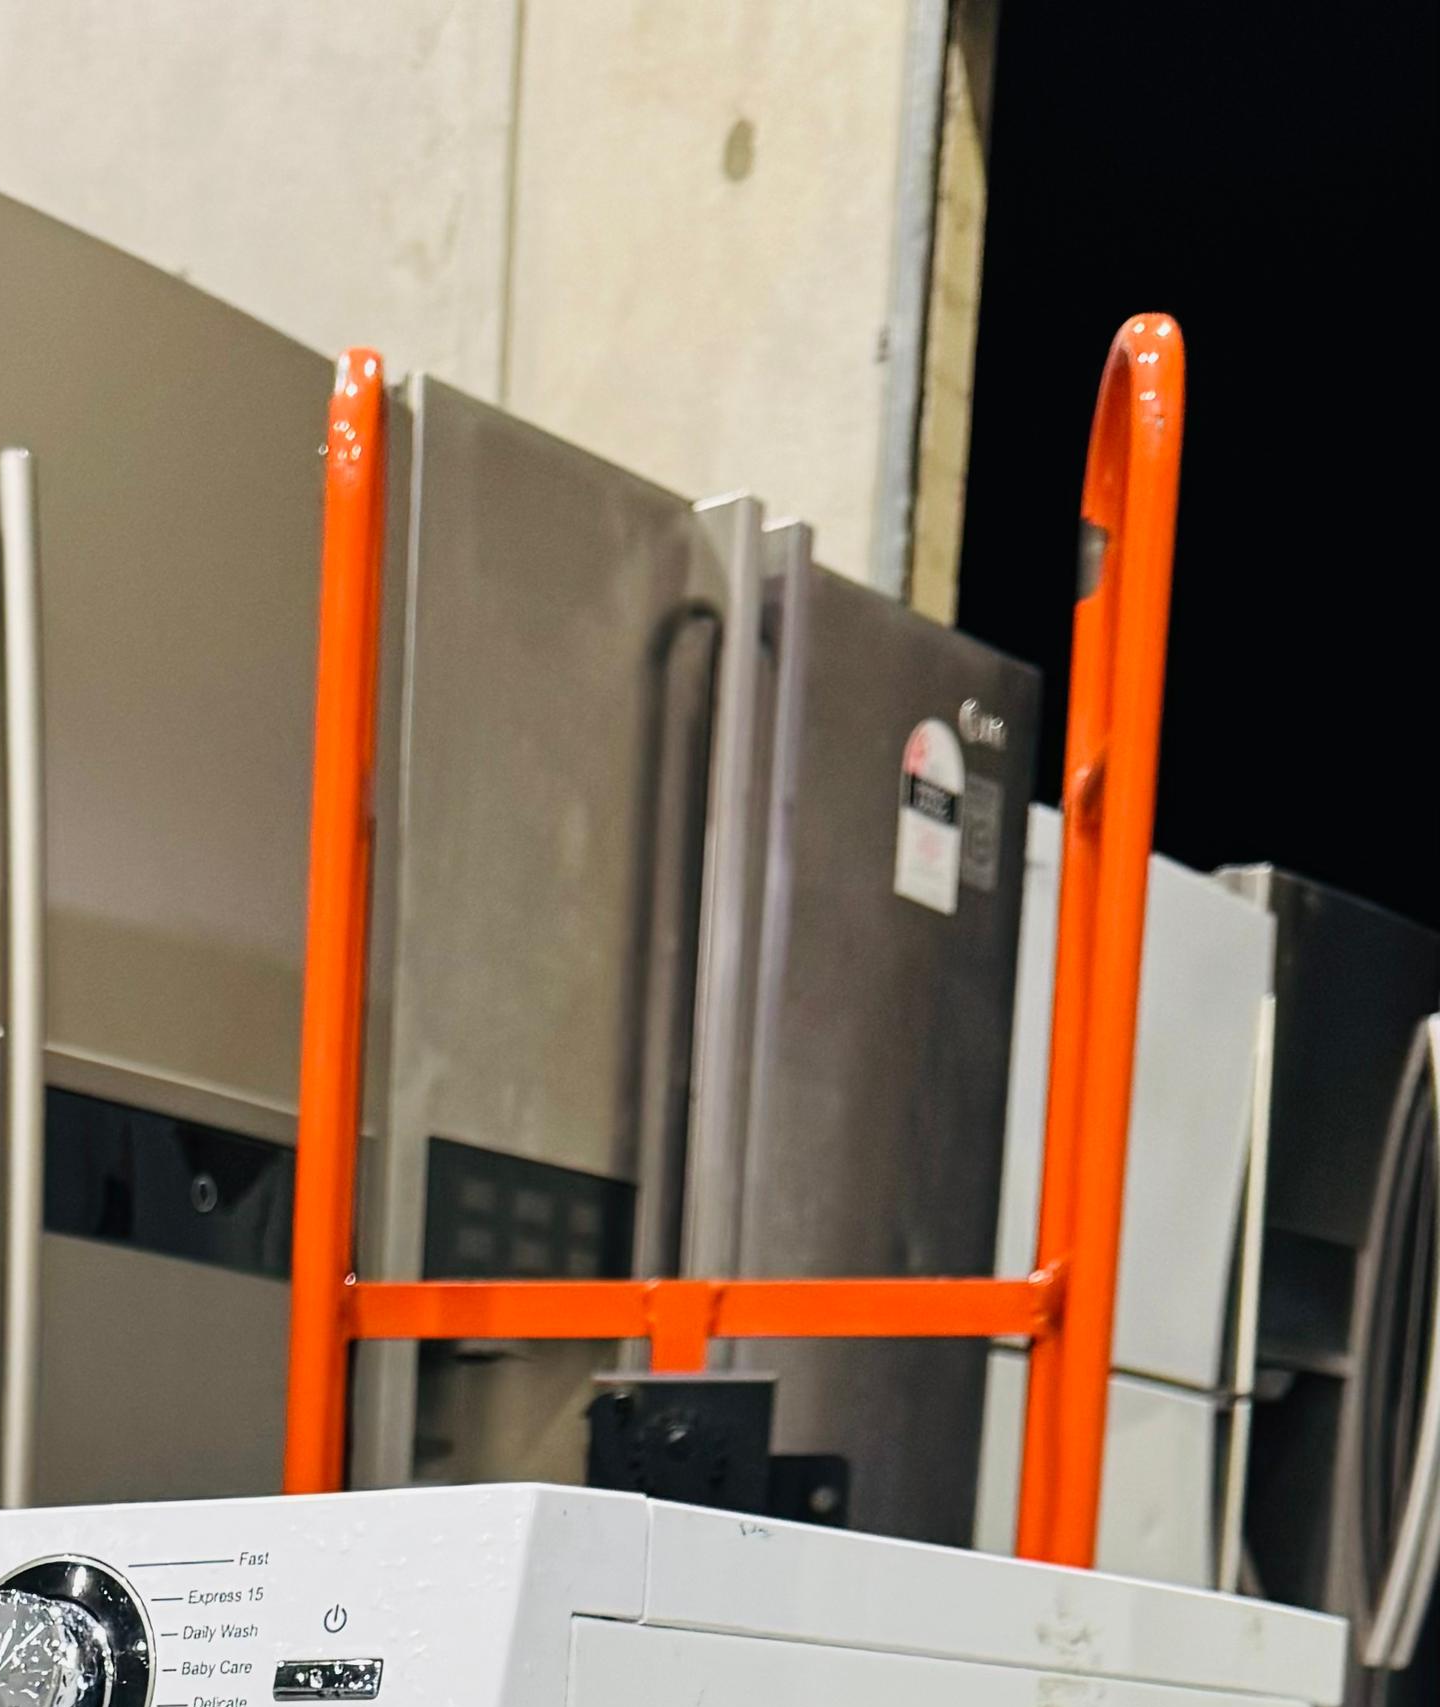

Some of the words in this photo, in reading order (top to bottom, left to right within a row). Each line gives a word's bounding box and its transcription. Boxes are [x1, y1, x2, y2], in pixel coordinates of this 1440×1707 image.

[239, 1552, 269, 1566] Fast
[188, 1588, 242, 1606] Express
[248, 1586, 264, 1601] 15
[183, 1625, 216, 1643] Daily
[221, 1624, 258, 1639] Wash
[181, 1661, 215, 1678] Baby
[220, 1660, 253, 1674] Care
